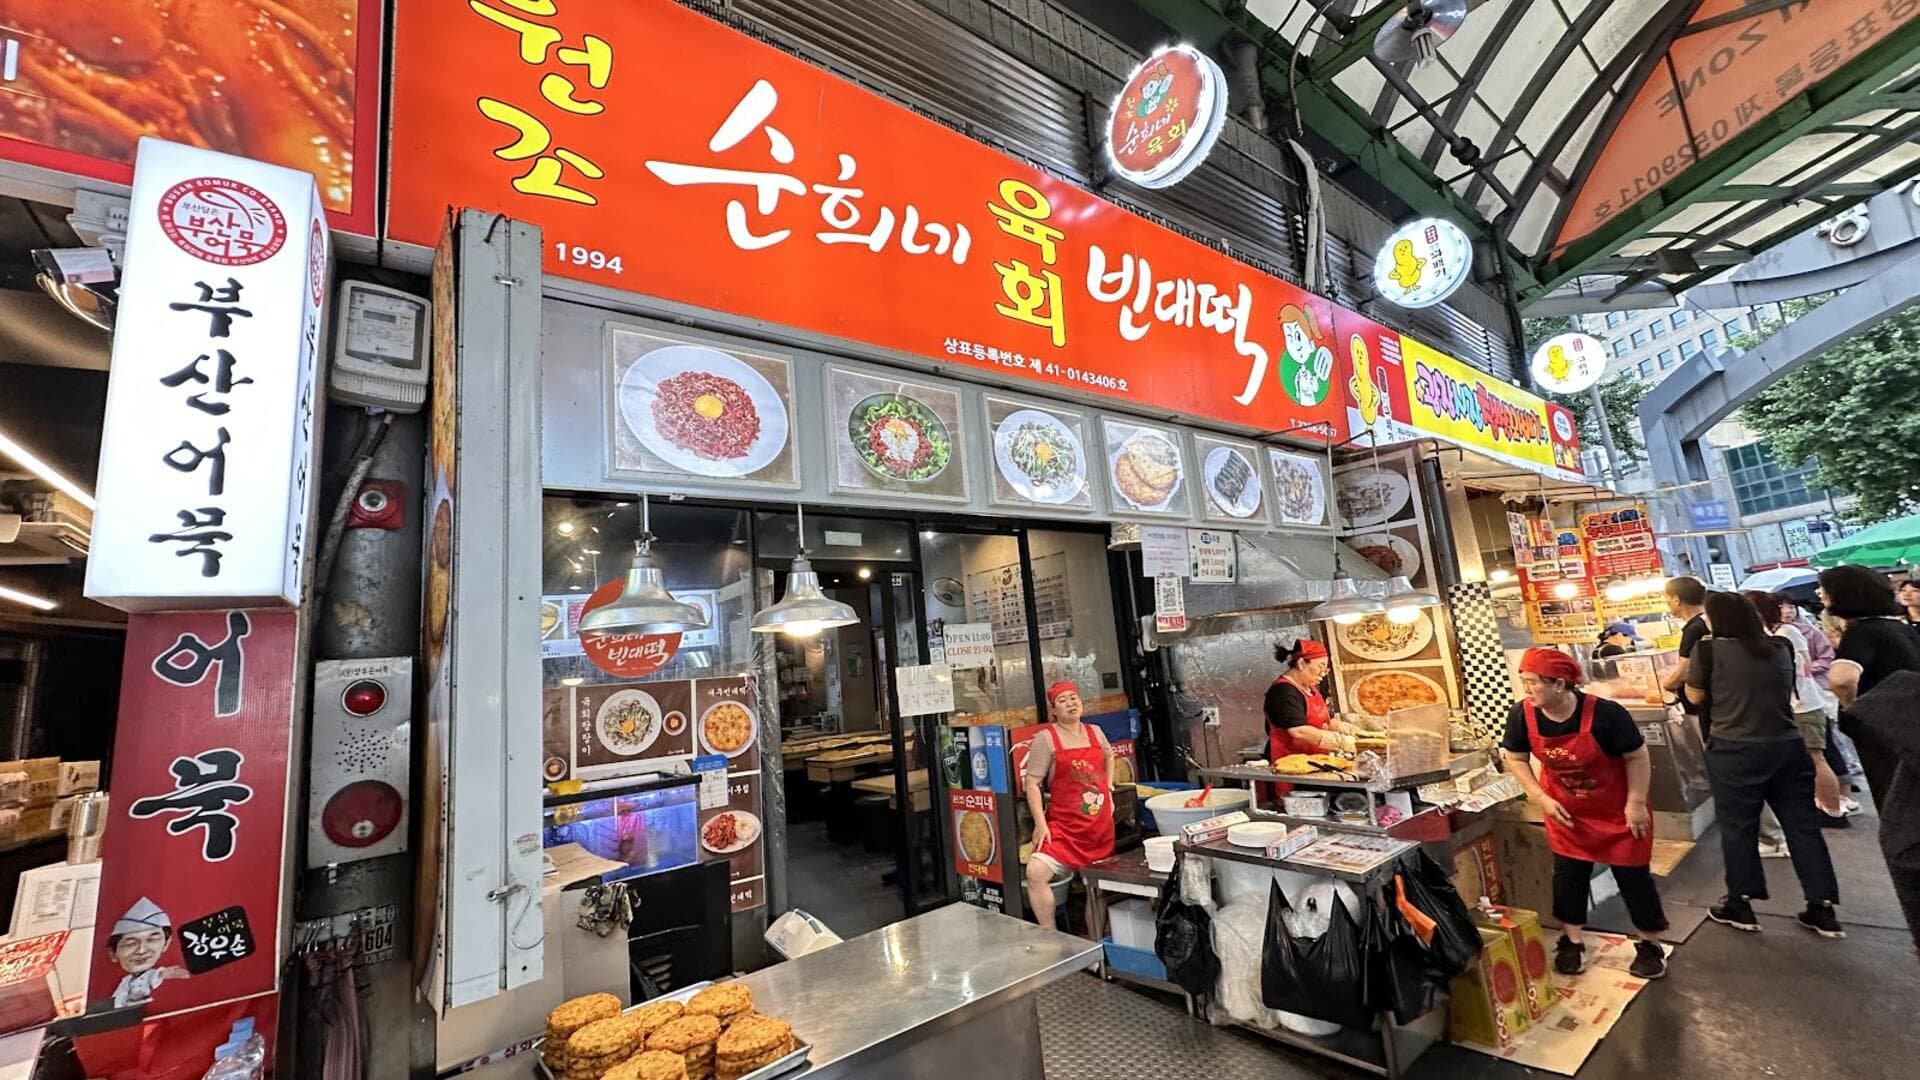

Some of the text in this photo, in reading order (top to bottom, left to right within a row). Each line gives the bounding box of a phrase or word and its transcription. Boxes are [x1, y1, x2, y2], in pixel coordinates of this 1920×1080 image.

[1118, 113, 1172, 155] 순희네
[1147, 118, 1186, 157] 육회
[645, 79, 972, 265] 순희네
[164, 183, 194, 205] BUSAN
[555, 243, 624, 275] 1994
[986, 177, 1066, 348] 육회
[1086, 244, 1269, 407] 빈대떡
[943, 337, 1025, 369] 상표등록번호
[1029, 358, 1043, 374] 제
[148, 277, 254, 577] 부산어묵
[607, 638, 669, 667] 빈대떡
[946, 633, 970, 643] OPEN
[948, 646, 972, 656] CLOSE
[129, 611, 254, 862] 어묵
[966, 794, 994, 811] 순희네
[183, 929, 246, 960] 장우손
